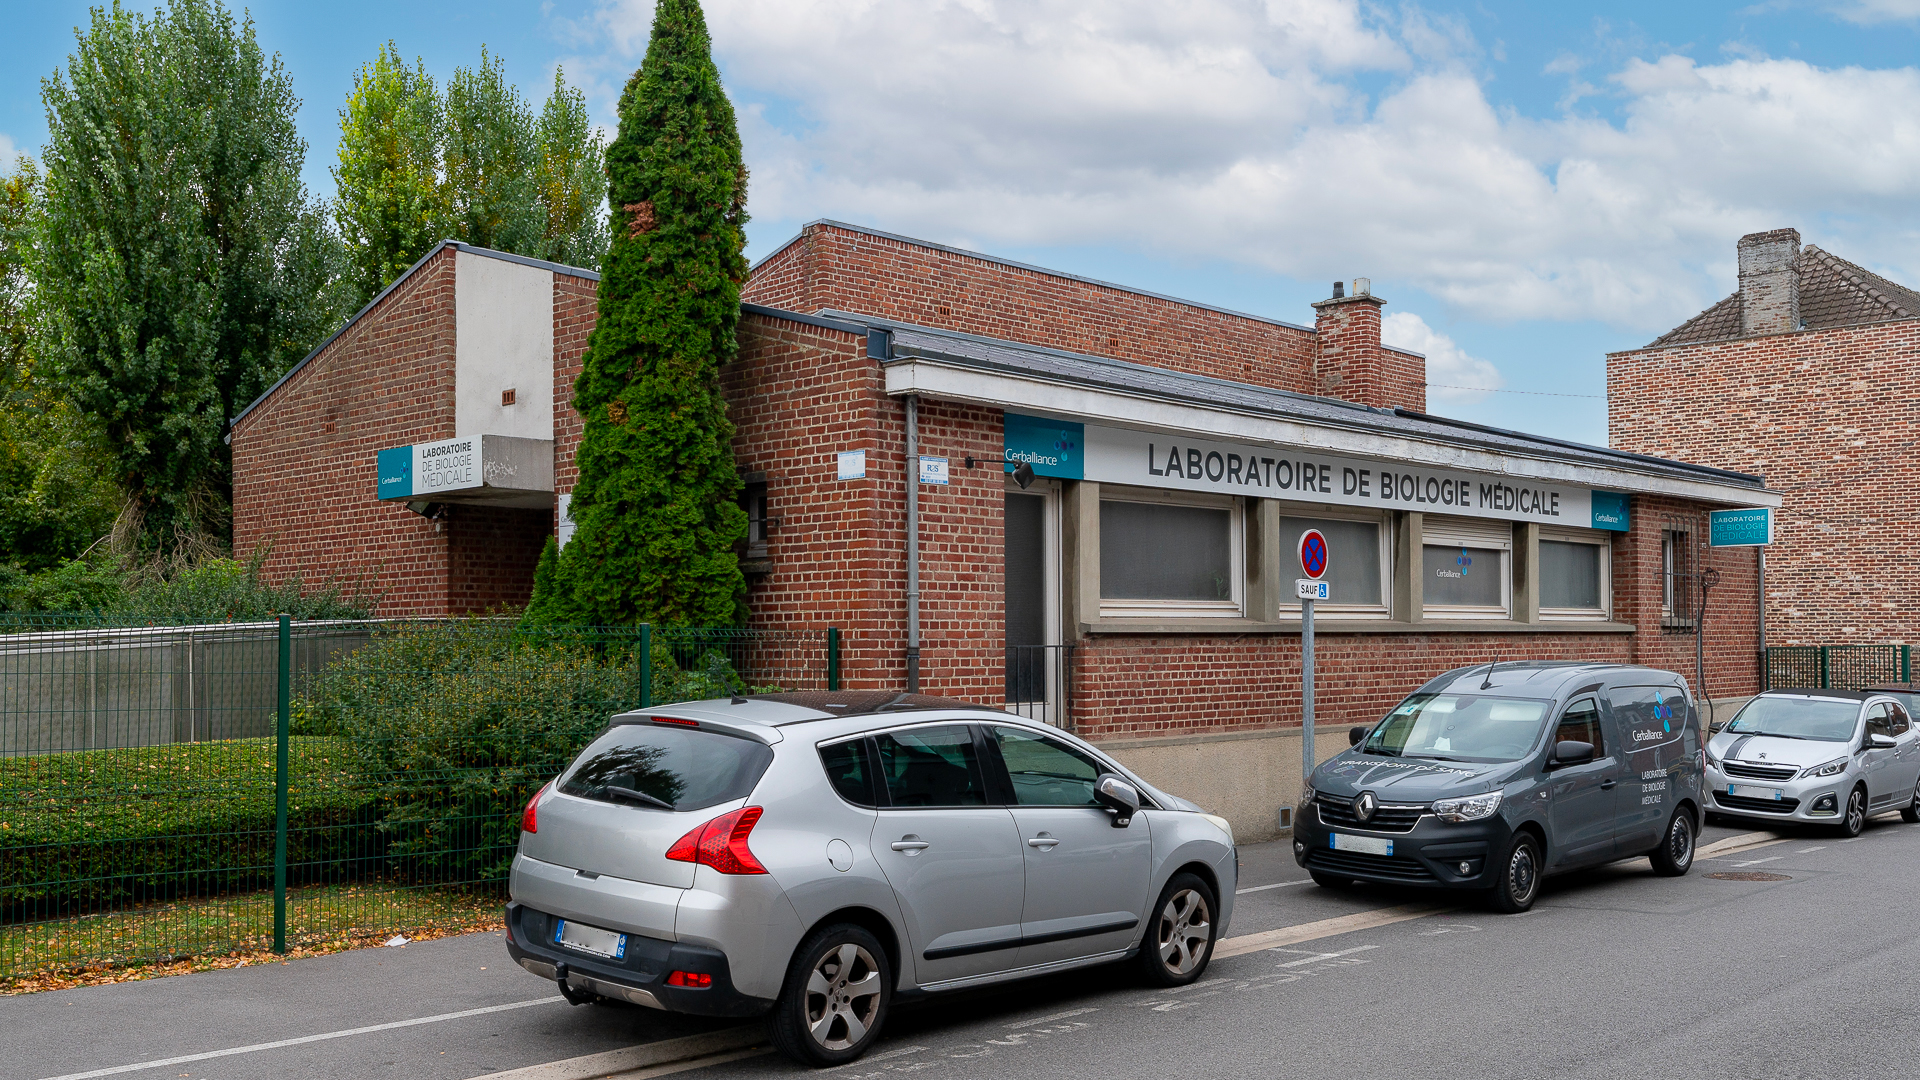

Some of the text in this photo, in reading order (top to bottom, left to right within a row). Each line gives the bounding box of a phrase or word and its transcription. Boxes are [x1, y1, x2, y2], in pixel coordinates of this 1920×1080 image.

[422, 441, 472, 459] LABORATOIRE
[422, 460, 433, 473] DE
[435, 453, 472, 471] BIOLOGIE
[1005, 448, 1058, 466] Cerballiance
[1148, 442, 1560, 517] LABORATOIRE DE BIOLOGIE MÉDICALE
[1713, 514, 1766, 524] LABORATOIRE
[1713, 522, 1766, 532] DE BIOLOGIE
[1436, 568, 1461, 578] Cerballiance
[1300, 584, 1318, 595] SAUF
[1632, 729, 1663, 742] Cerballiance
[1338, 759, 1417, 769] TRANSPORT
[1435, 767, 1478, 778] SANG
[1641, 768, 1668, 780] LABORATOIRE
[1642, 781, 1666, 793] DE BIOLOGIE
